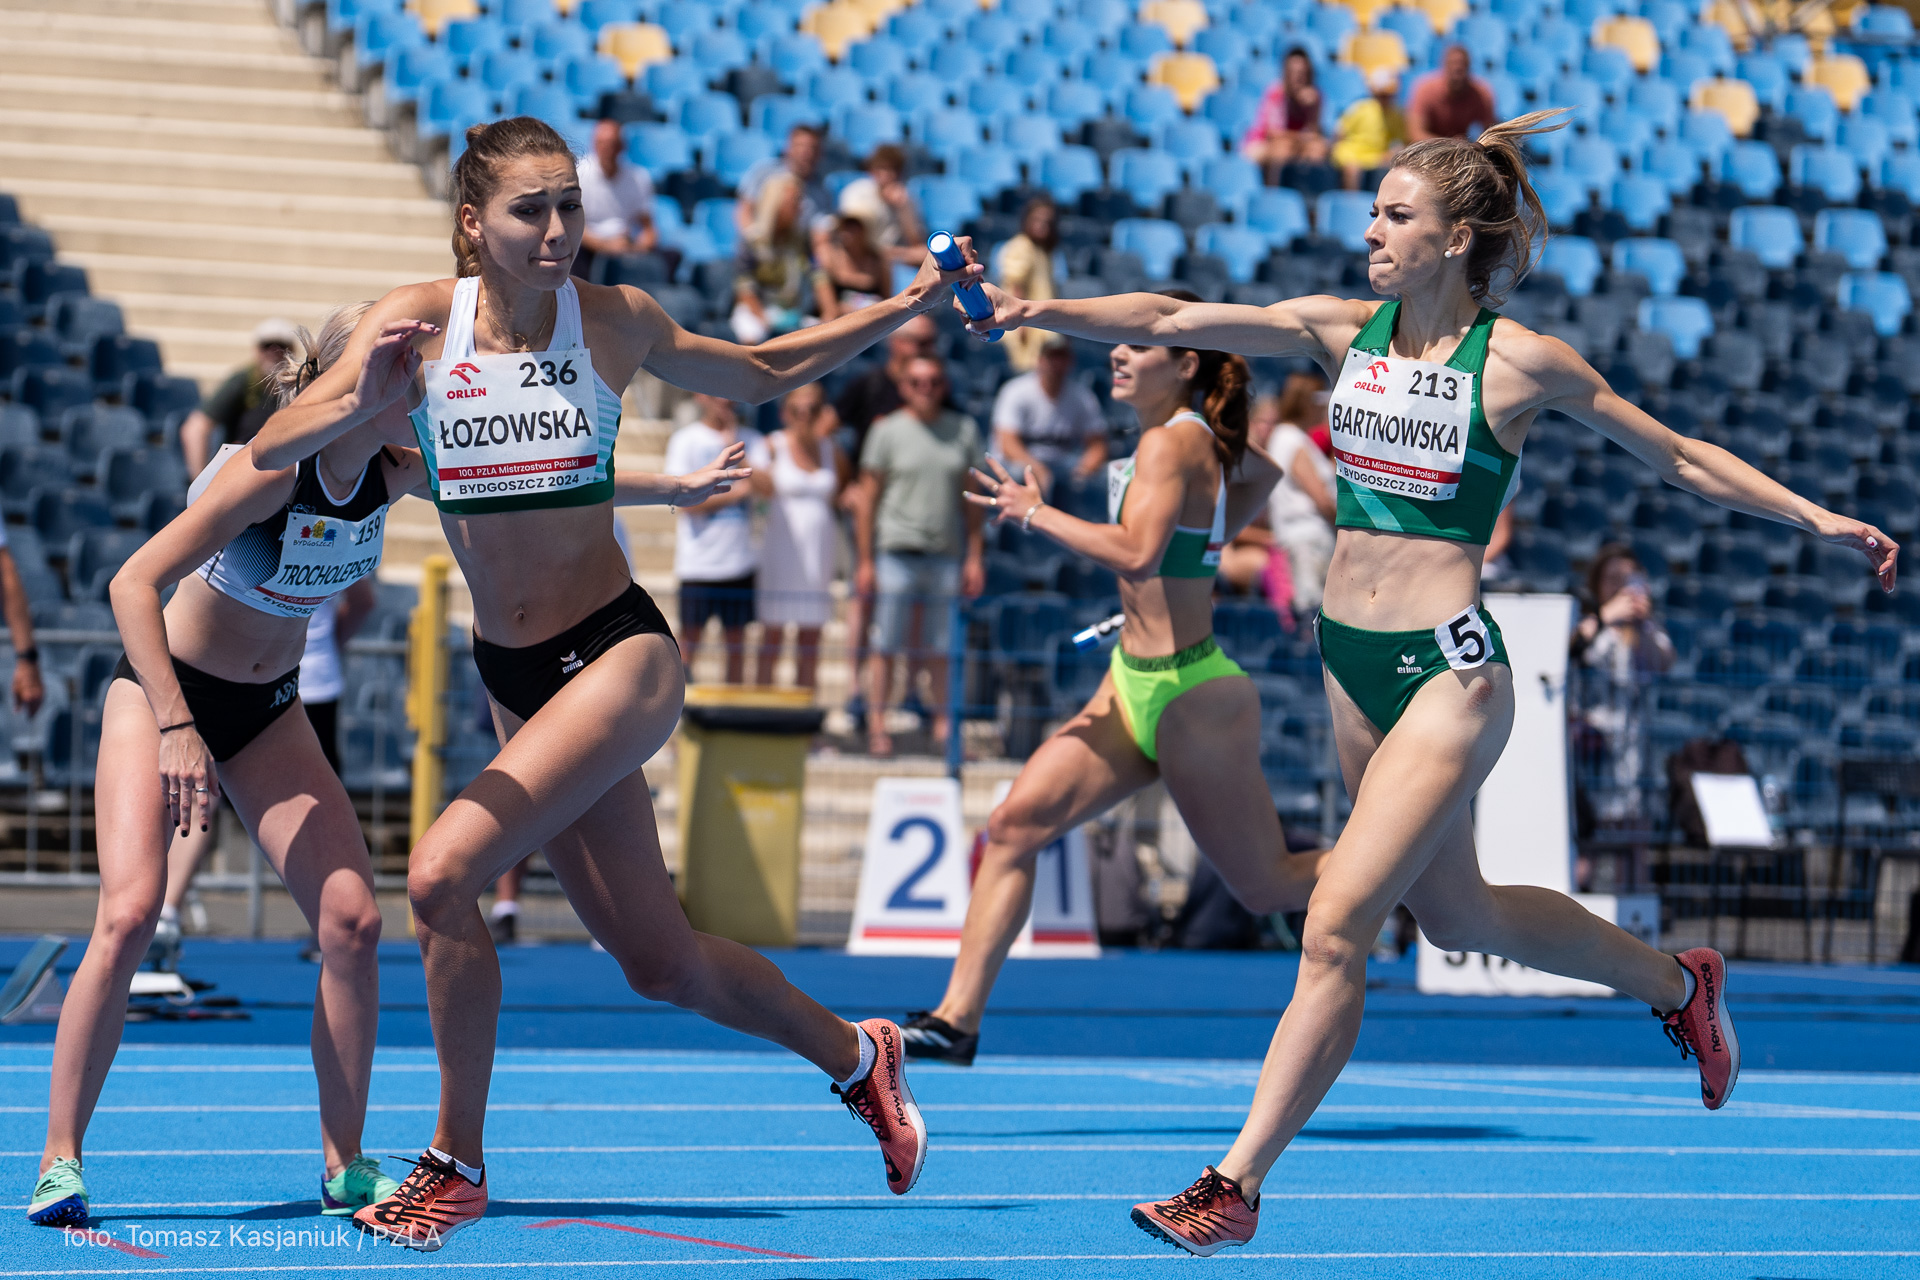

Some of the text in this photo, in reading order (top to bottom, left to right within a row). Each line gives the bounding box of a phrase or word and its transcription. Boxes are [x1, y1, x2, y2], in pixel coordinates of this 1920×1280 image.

[519, 359, 578, 388] 236
[1354, 381, 1386, 395] ORLEN
[1408, 370, 1458, 401] 213
[447, 387, 487, 400] ORLEN
[439, 407, 592, 449] ŁOZOWSKA
[1332, 403, 1459, 454] BARTNOWSKA
[458, 459, 579, 477] 100. PZLA Mistrzostwa Polski
[1343, 453, 1439, 480] 100. PZLA Mistrzostwa Polski
[1344, 466, 1438, 497] BYDGOSZCZ 2024
[459, 474, 579, 495] BYDGOSZCZ 2024
[355, 514, 380, 546] 159
[277, 555, 378, 586] TROCHOLEPSZA
[1448, 614, 1485, 663] 5
[1397, 665, 1423, 674] erima
[885, 816, 947, 910] 2
[1040, 834, 1070, 916] 1
[1701, 962, 1721, 1053] new balance
[881, 1025, 907, 1126] new balance
